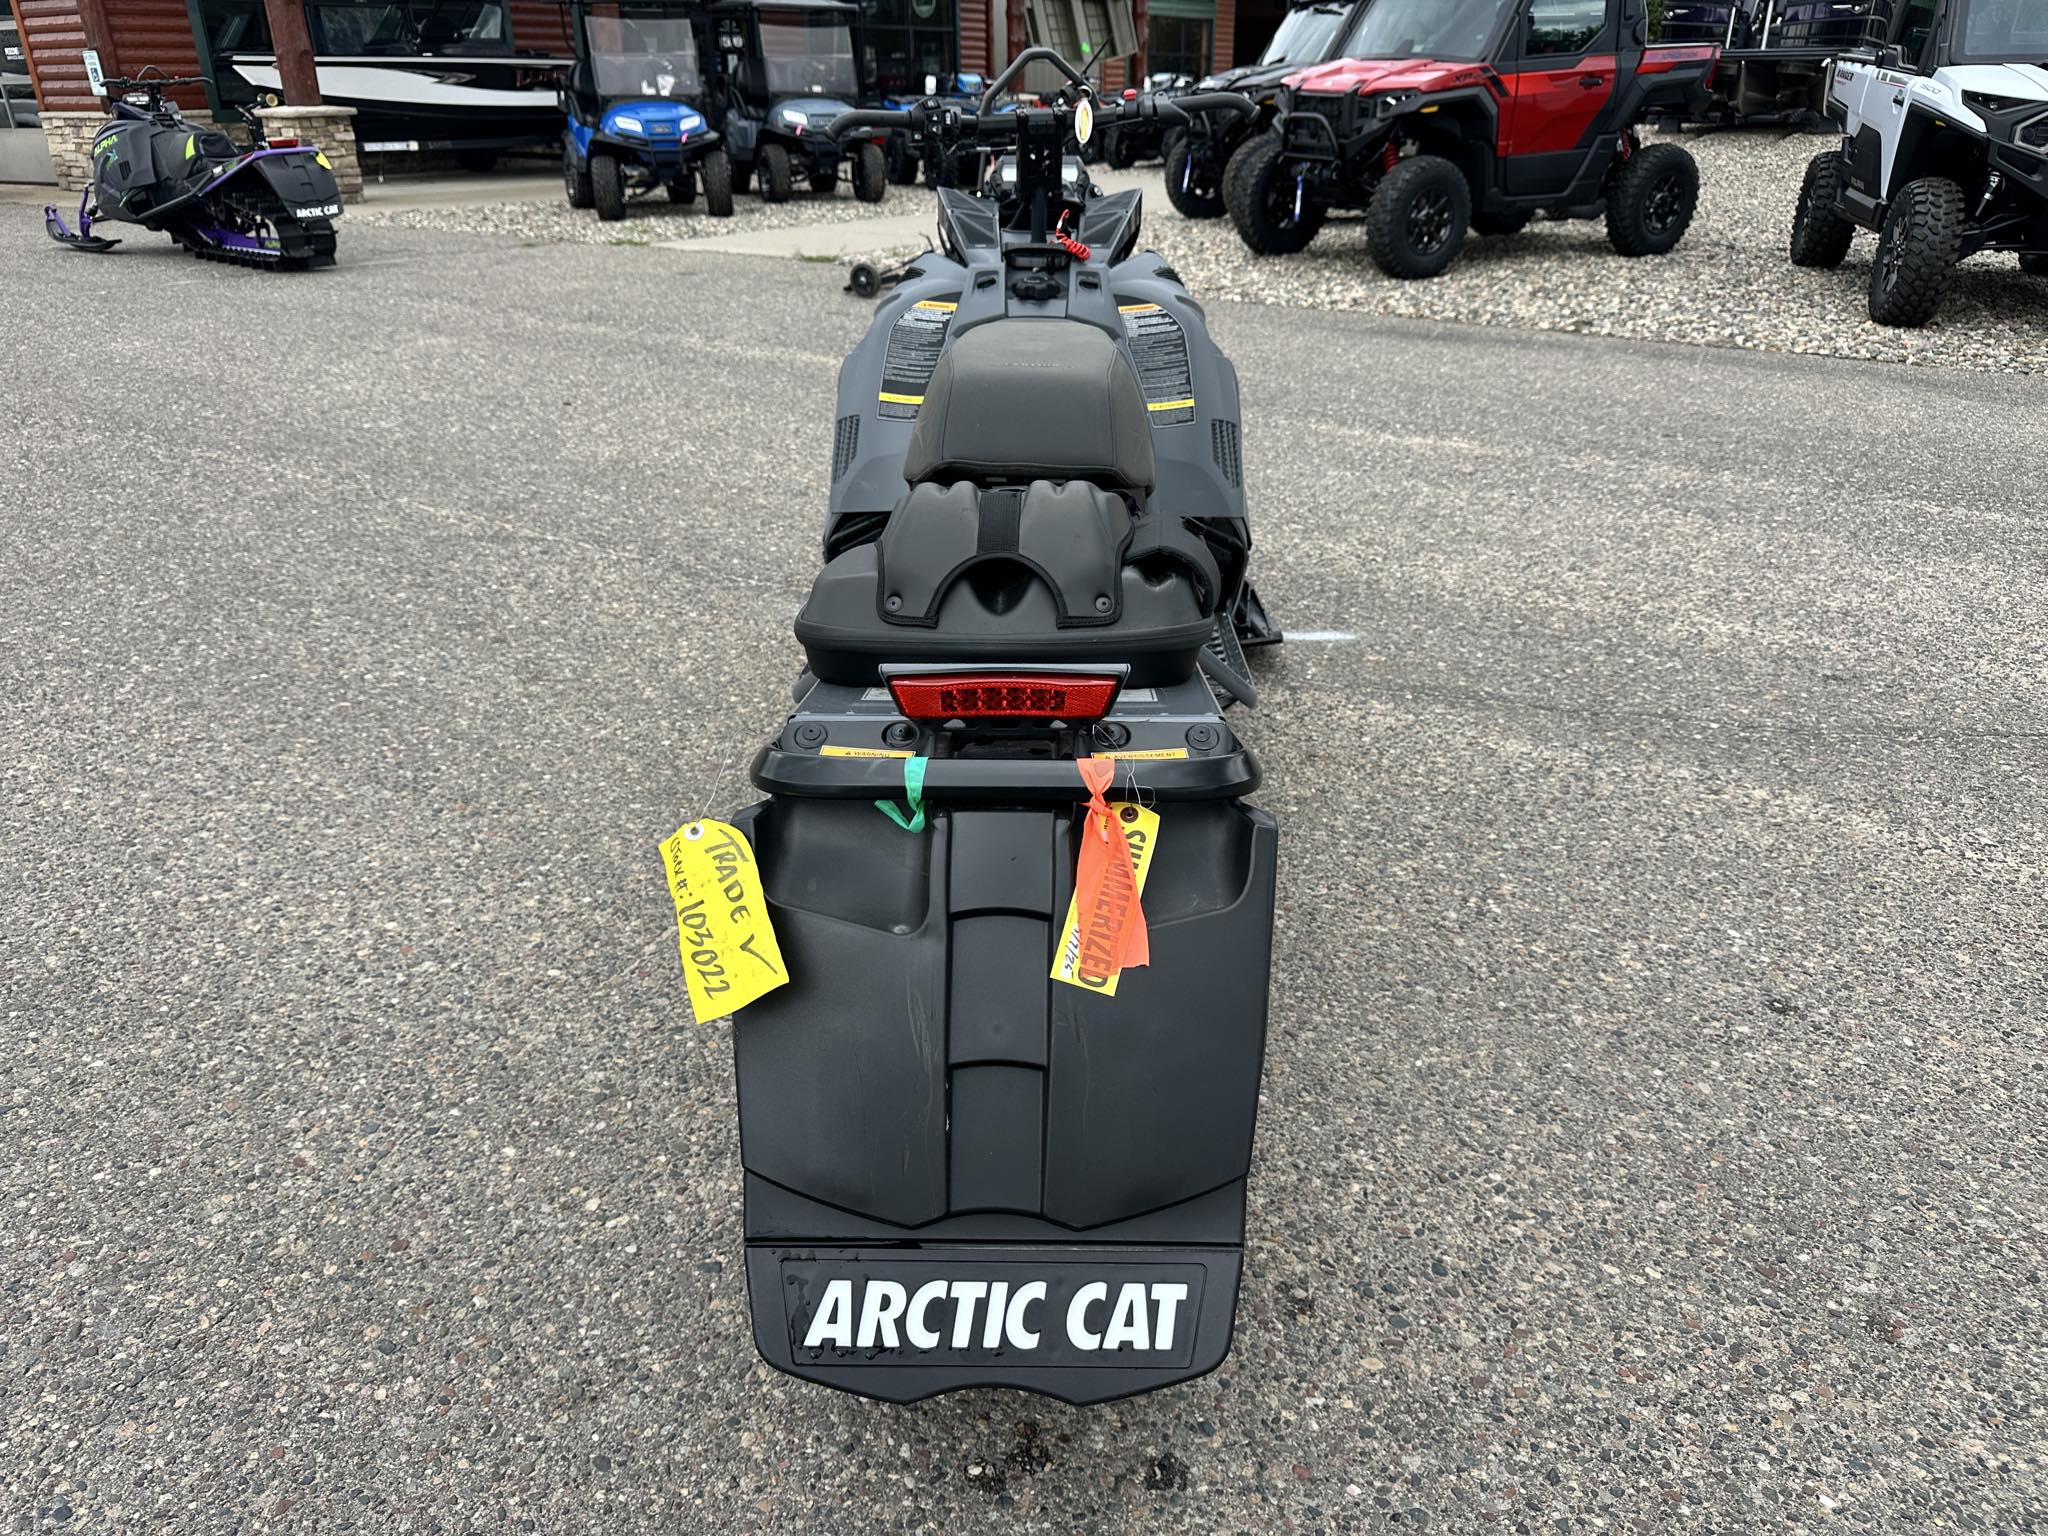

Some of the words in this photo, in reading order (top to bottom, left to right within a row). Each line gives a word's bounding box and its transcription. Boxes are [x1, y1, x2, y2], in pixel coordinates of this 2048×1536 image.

[296, 206, 323, 218] ARCTIC
[323, 204, 339, 215] CAT
[854, 751, 890, 759] WARNING
[1113, 751, 1176, 760] AVERTISSEMENT
[704, 828, 751, 924] TRADE
[678, 899, 731, 1000] 103022
[802, 1279, 1048, 1350] ARCTIC
[1065, 1281, 1189, 1351] CAT
